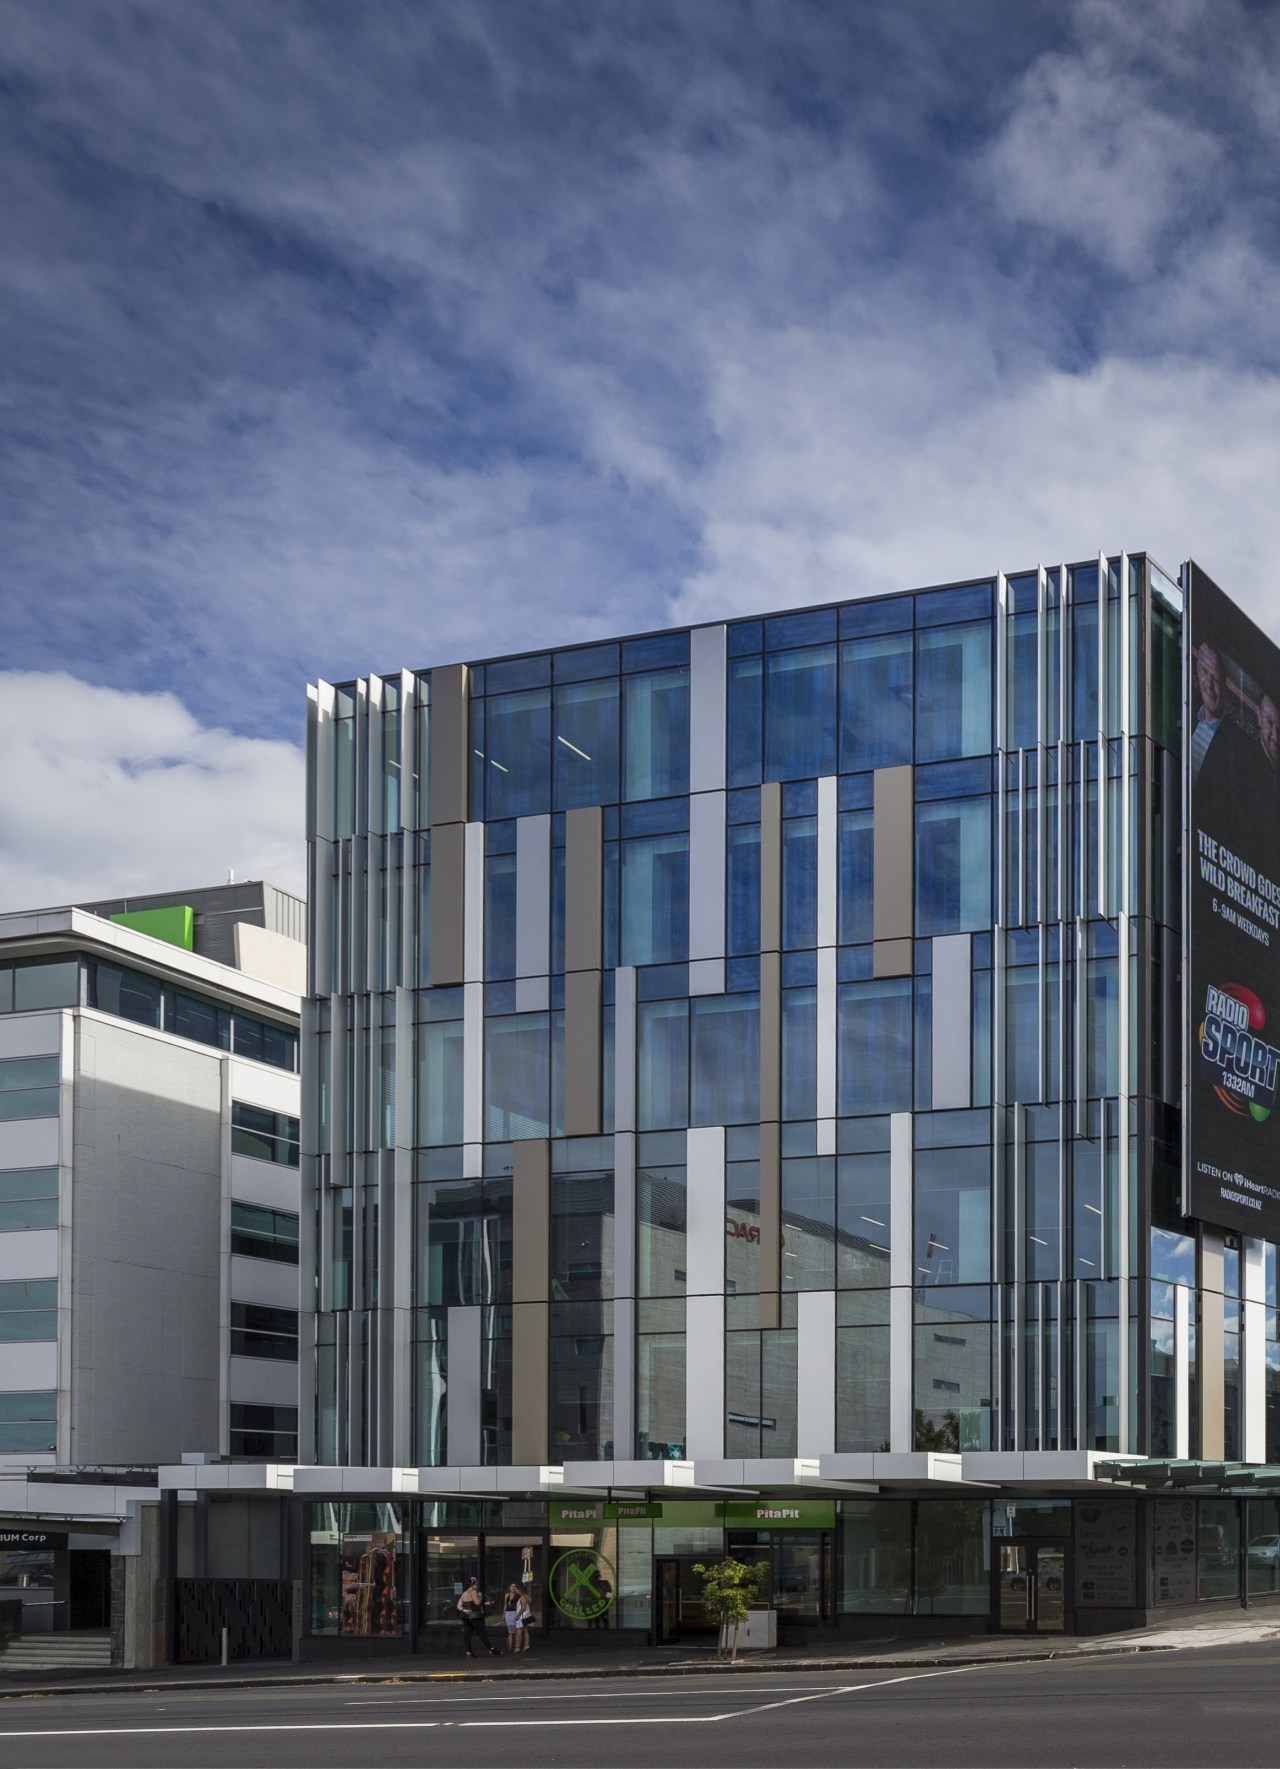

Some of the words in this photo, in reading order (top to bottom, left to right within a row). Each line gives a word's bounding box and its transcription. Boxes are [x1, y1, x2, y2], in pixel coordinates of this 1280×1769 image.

[1197, 828, 1218, 863] THE
[1219, 845, 1256, 889] CROWD
[1200, 856, 1226, 892] WILD
[1227, 875, 1280, 929] BREAKFAST
[1237, 913, 1270, 947] WEEKDAYS
[1206, 984, 1249, 1031] RADIO
[1222, 1070, 1255, 1098] 1332AM
[1197, 1161, 1221, 1179] LISTEN
[1222, 1170, 1233, 1183] ON
[1220, 1187, 1262, 1210] RADIOSPORT.CO.NZ
[561, 1509, 597, 1519] PitaPi
[21, 1533, 46, 1543] Corp
[559, 1598, 607, 1616] GRILLED
